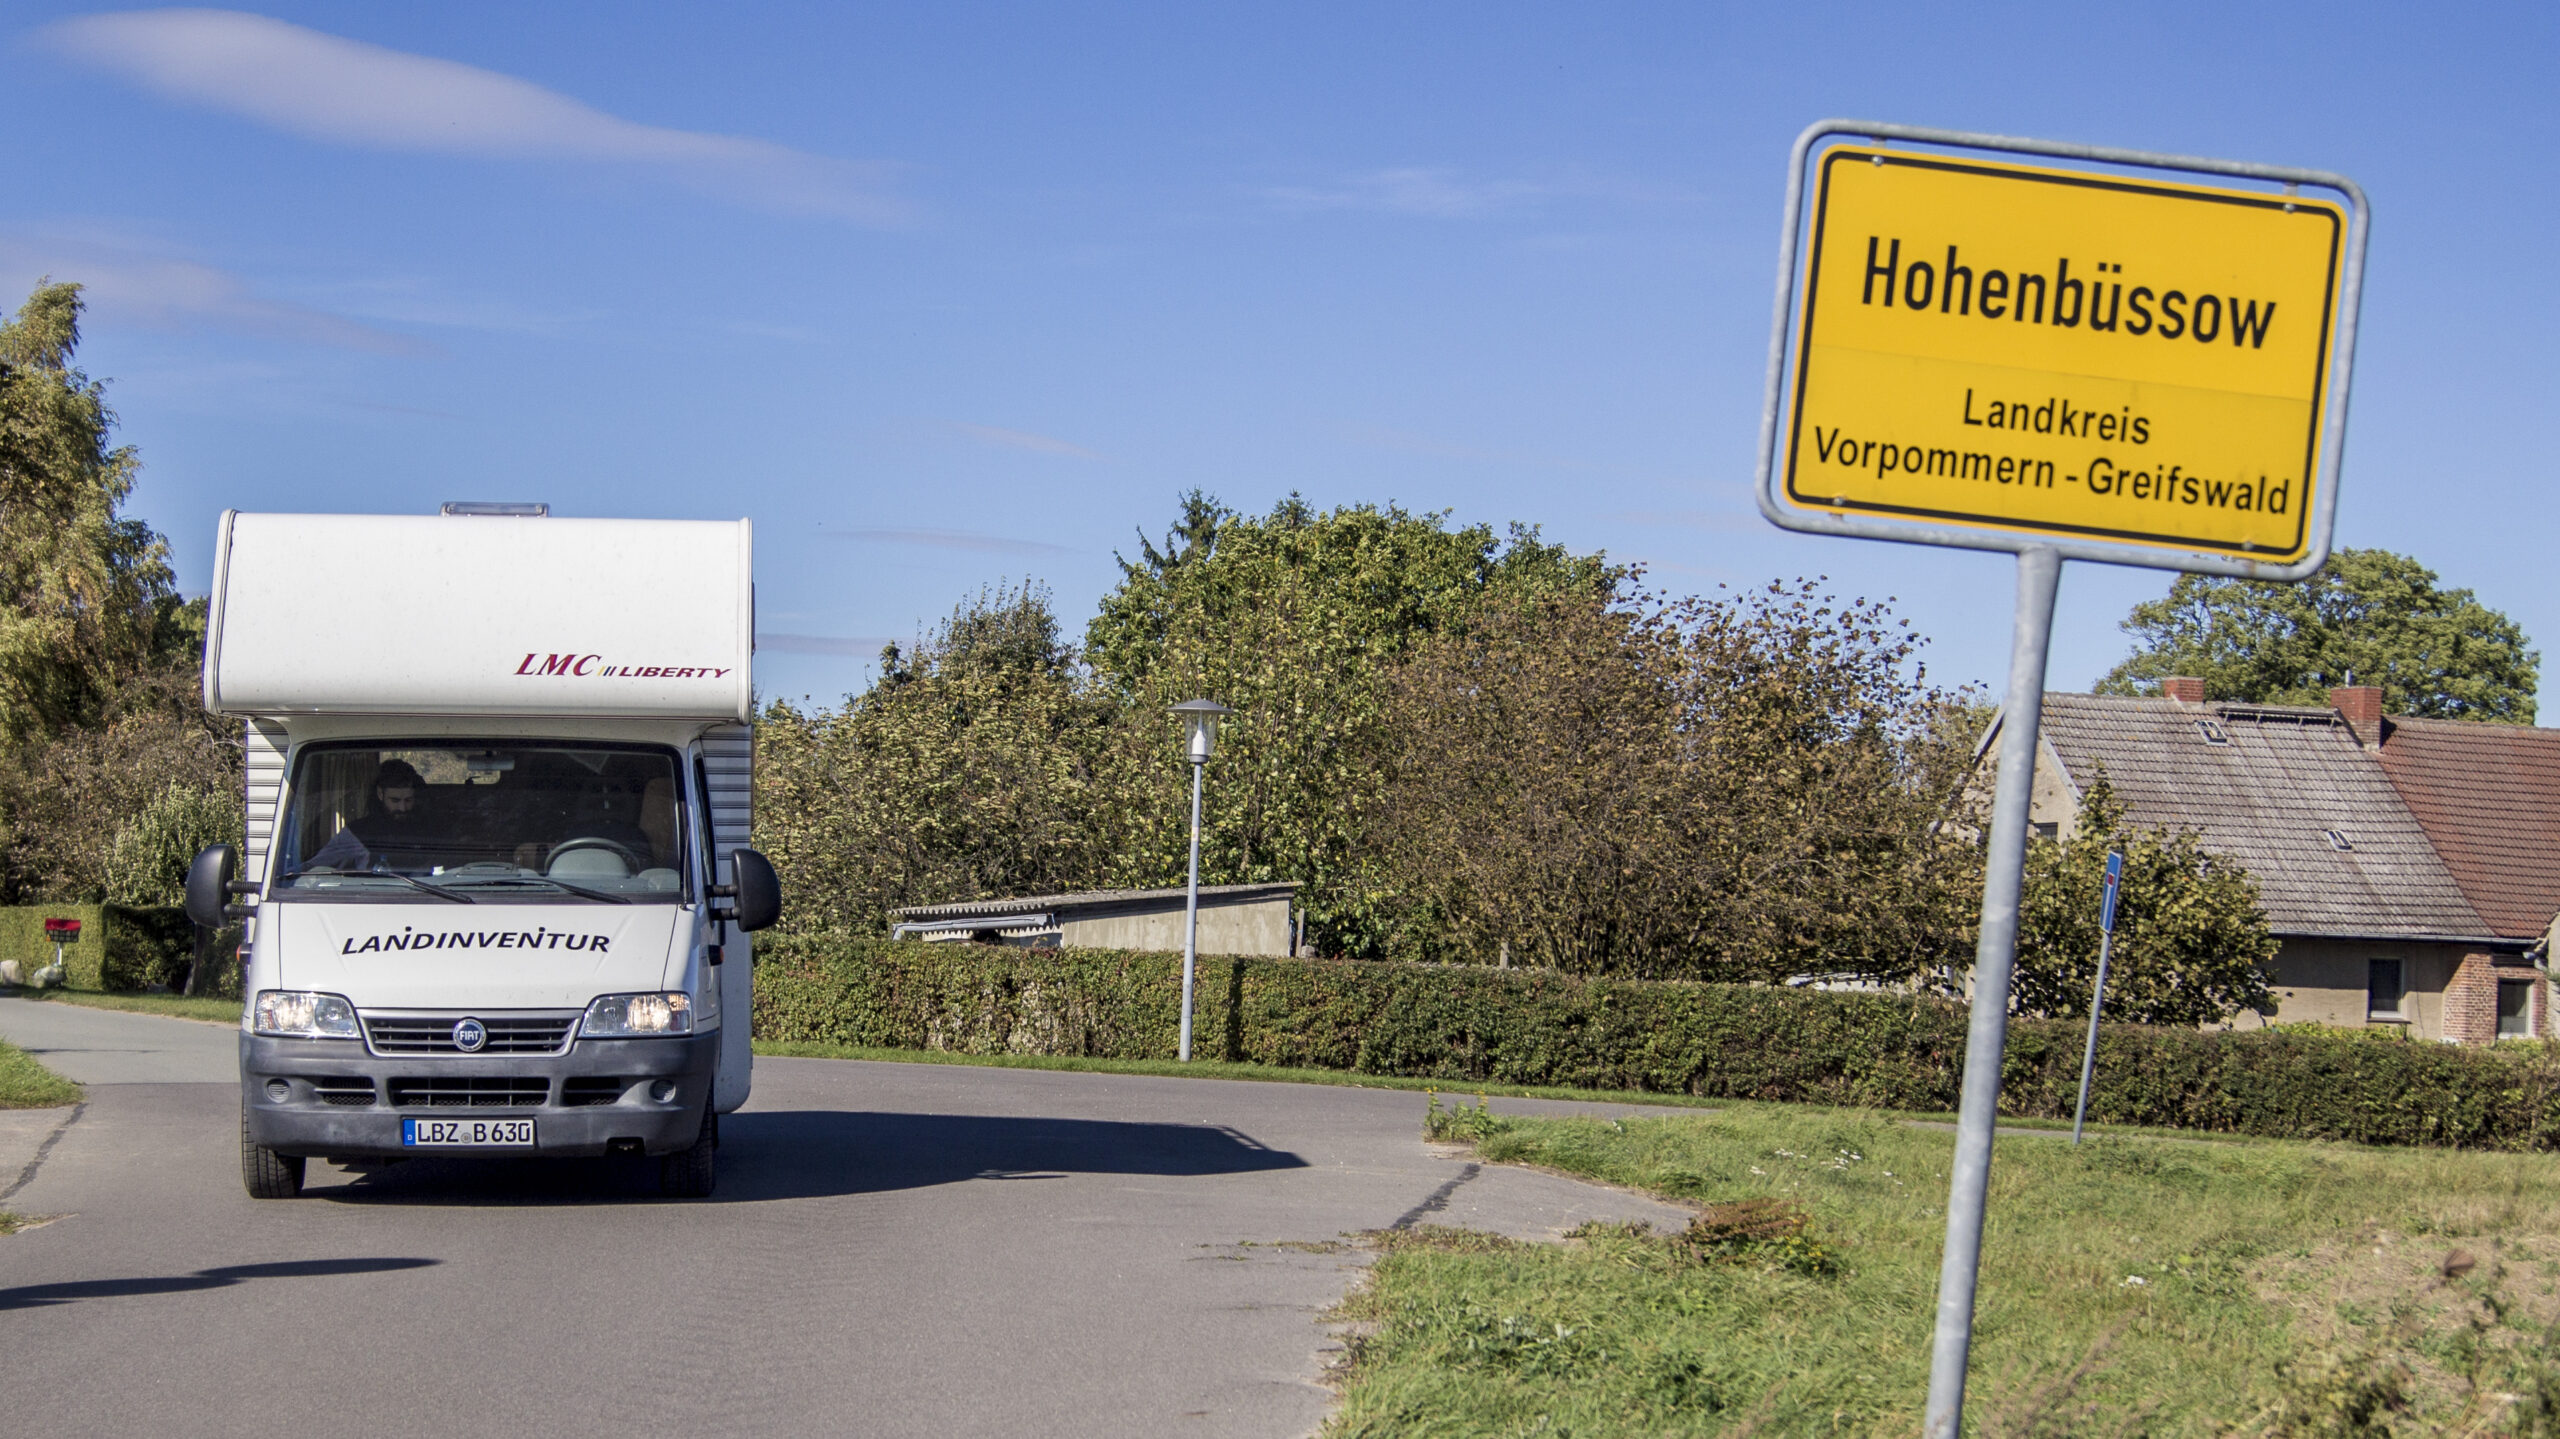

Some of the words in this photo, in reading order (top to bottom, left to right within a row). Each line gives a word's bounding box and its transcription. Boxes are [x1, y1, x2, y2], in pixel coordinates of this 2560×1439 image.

[1861, 235, 2277, 350] Hohenbüssow
[1963, 388, 2151, 444] Landkreis
[514, 653, 602, 677] LMC
[618, 666, 731, 679] LIBERTY
[460, 1030, 480, 1041] FIAT
[417, 1123, 459, 1143] LBZ
